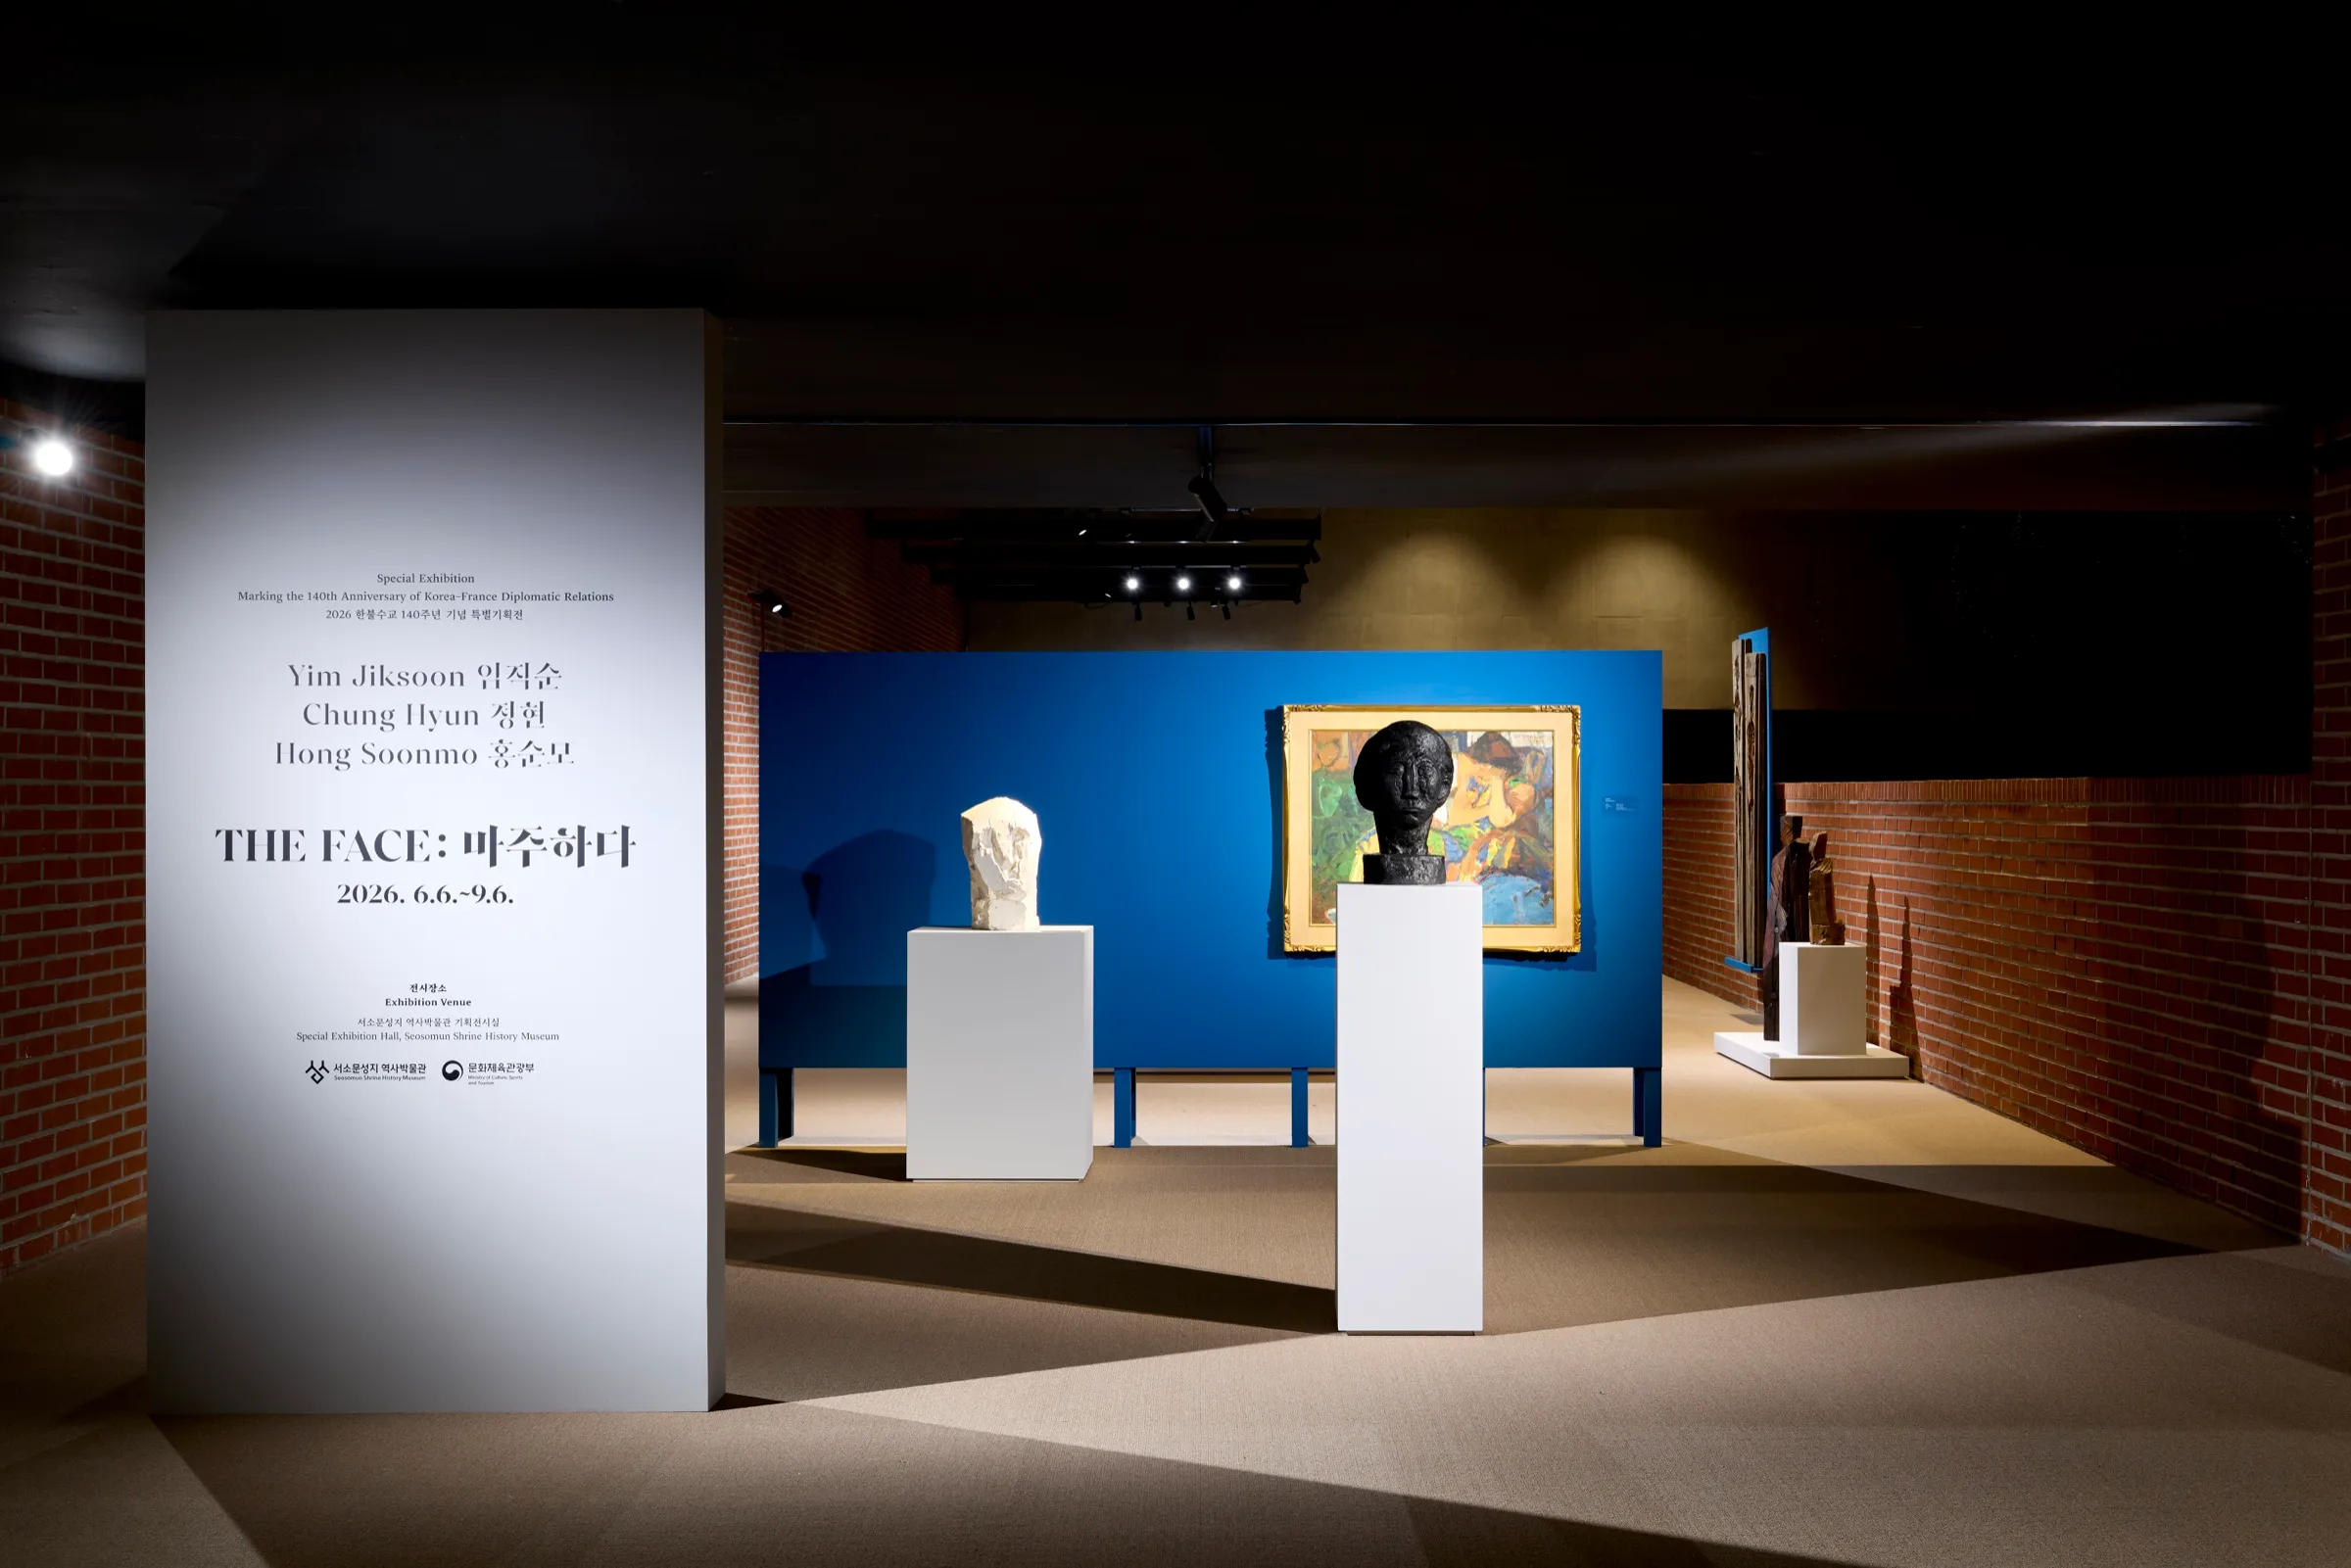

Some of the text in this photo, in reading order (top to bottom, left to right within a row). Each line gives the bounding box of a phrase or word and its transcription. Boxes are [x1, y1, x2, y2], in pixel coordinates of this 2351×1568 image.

[377, 573, 475, 586] Special Exhibition
[238, 591, 282, 603] Marking
[287, 591, 304, 601] the
[307, 591, 338, 601] 140th
[341, 591, 407, 603] Anniversary
[409, 591, 421, 601] of
[502, 591, 561, 603] Diplomatic
[564, 591, 615, 602] Relations
[326, 608, 523, 621] 2026 한불수교 140주년 기념 특별기획전
[288, 661, 562, 690] Yim Jiksoon 임직순
[303, 699, 546, 733] Chung Hyun 정현
[276, 737, 575, 772] Hong Soonmo 홍순모
[216, 824, 637, 869] THE FACE: 마주하다
[337, 883, 514, 905] 2026. 6.6.~9.6.
[409, 982, 448, 994] 전시장소
[385, 997, 472, 1007] Exhibition Venue
[358, 1017, 500, 1028] 서소문성지 역사박물관 기획전시실
[296, 1030, 559, 1042] Special Exhibition Hall, Seosomun Shrine History Museum
[334, 1063, 426, 1073] 서소문성지 역사박물관
